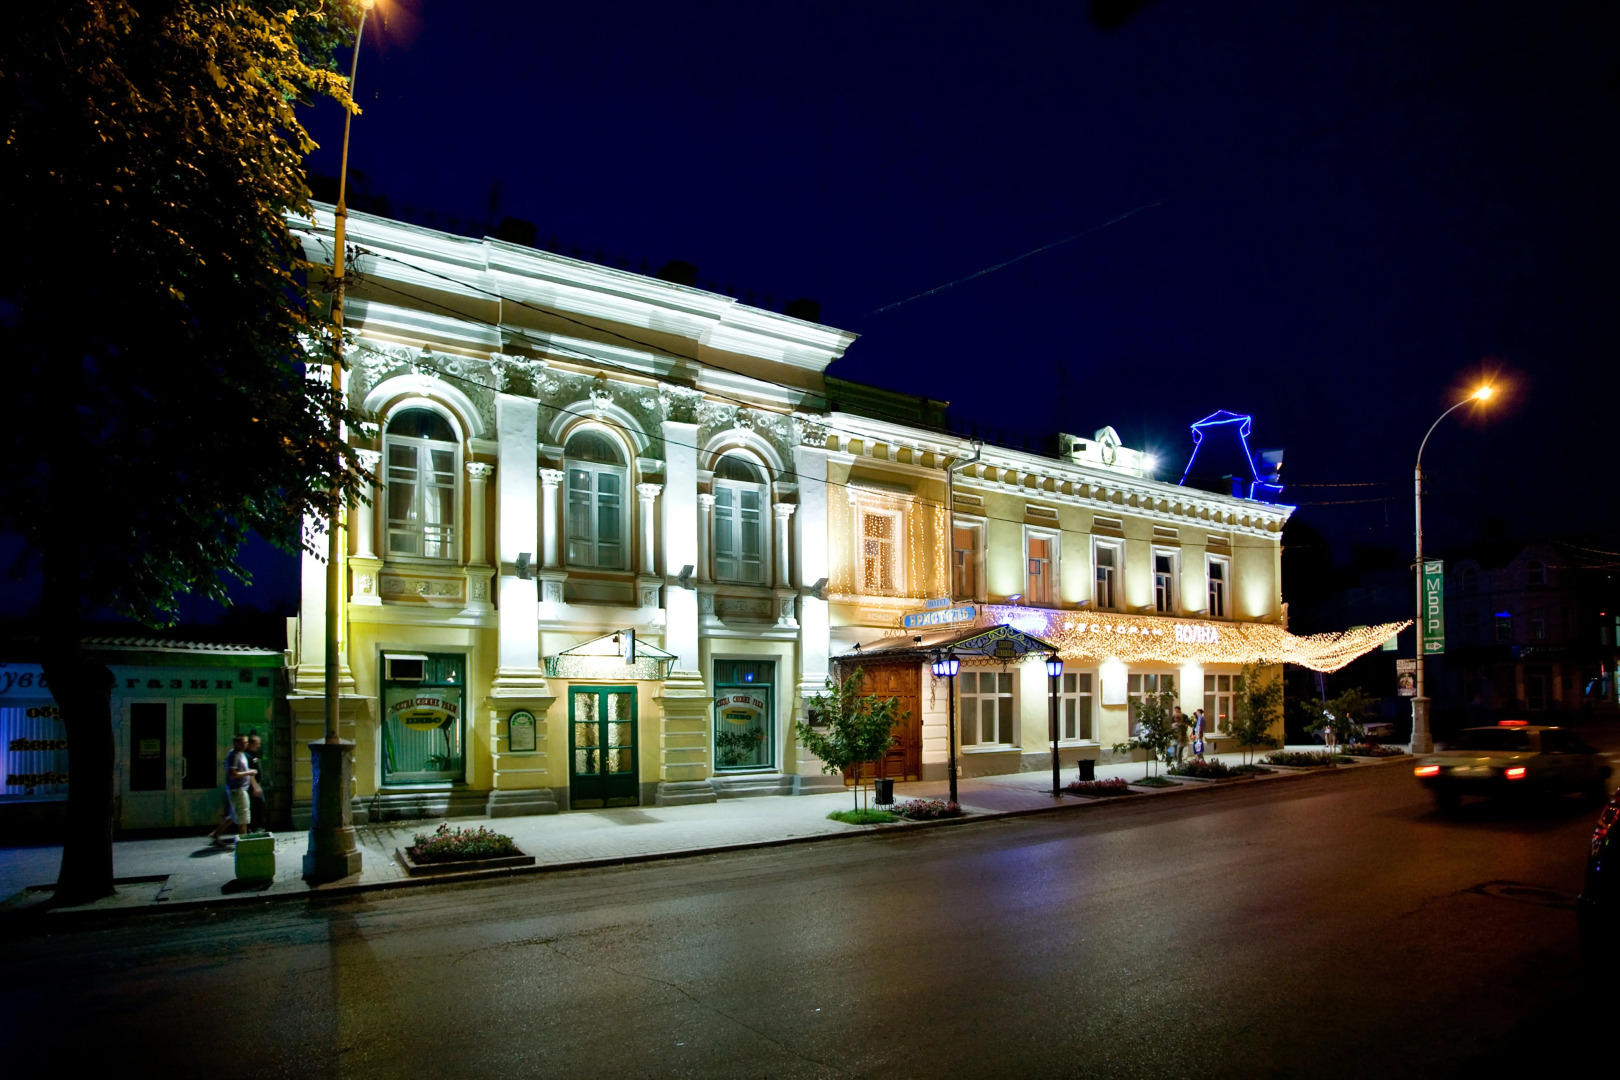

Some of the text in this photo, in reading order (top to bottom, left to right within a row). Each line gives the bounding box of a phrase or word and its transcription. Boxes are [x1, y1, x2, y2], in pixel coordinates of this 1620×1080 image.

[1426, 578, 1440, 633] МБРР
[910, 608, 969, 626] БРИСТОЛЬ
[1063, 622, 1219, 644] РЕСТОРАН ВОЛНА
[112, 677, 233, 689] газин
[9, 737, 68, 751] женс
[6, 771, 68, 788] мужс
